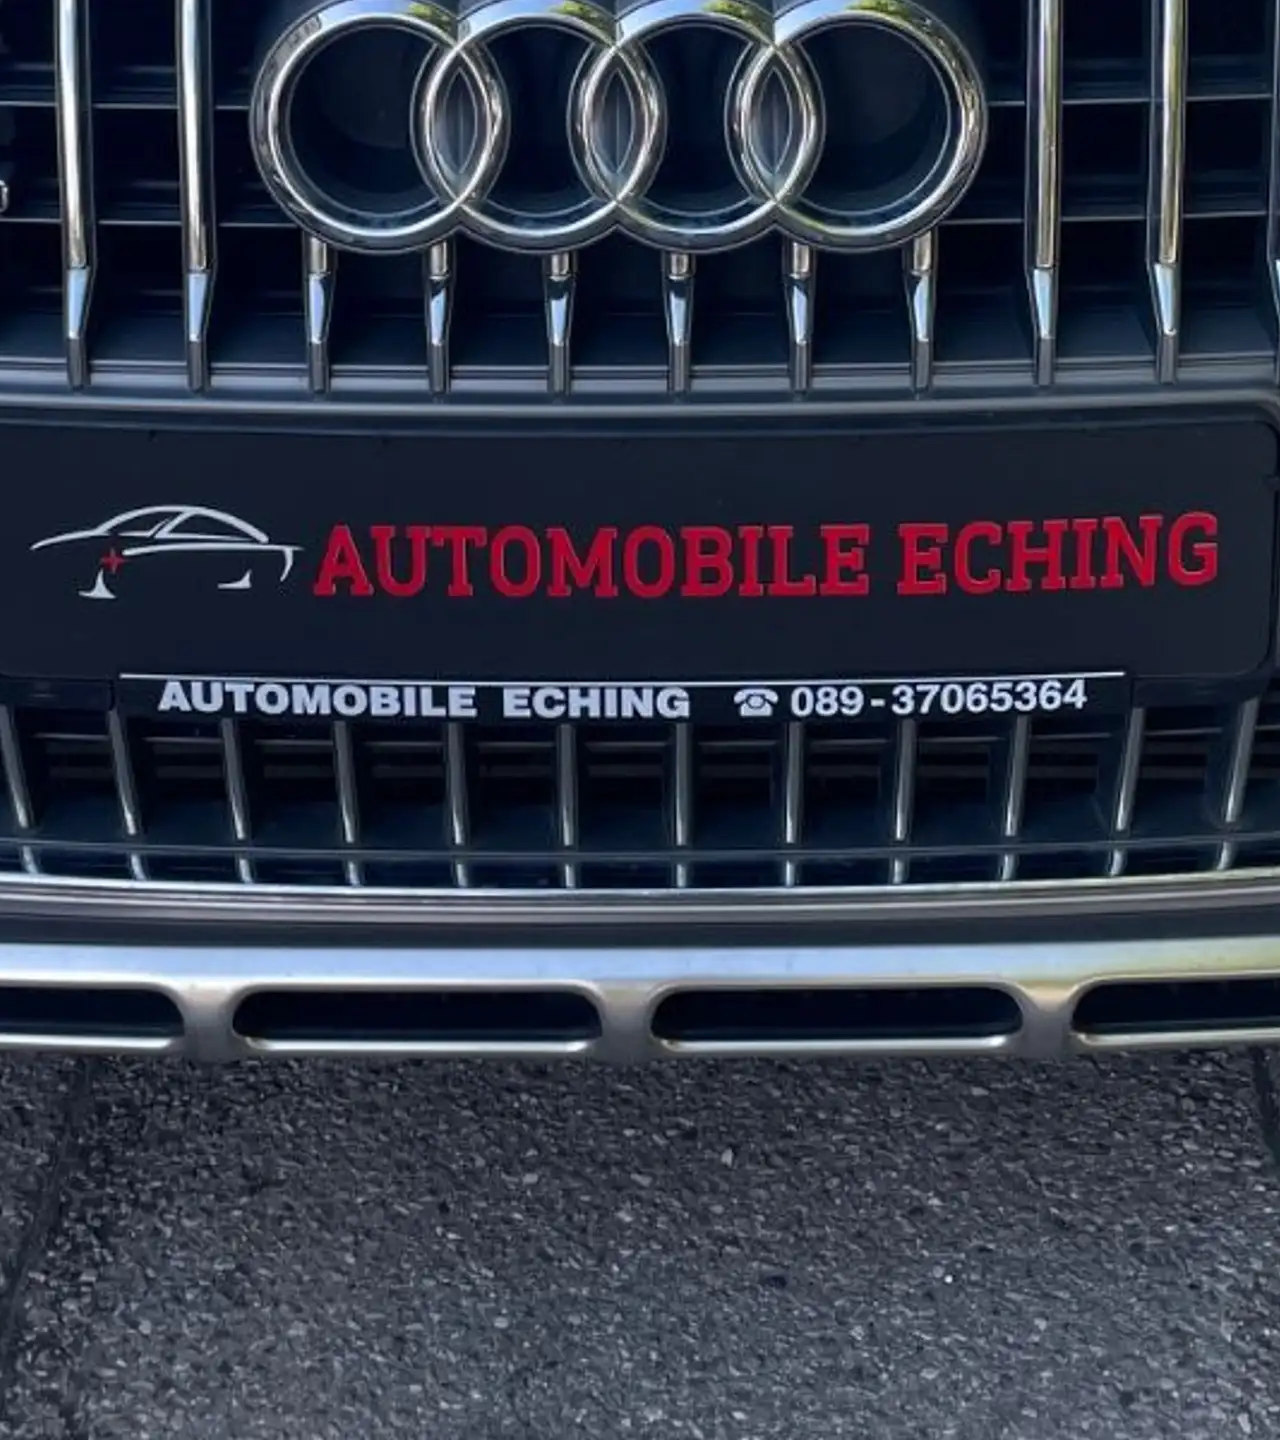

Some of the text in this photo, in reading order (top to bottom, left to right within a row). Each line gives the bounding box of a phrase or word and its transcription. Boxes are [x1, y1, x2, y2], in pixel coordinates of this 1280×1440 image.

[313, 510, 1219, 598] AUTOMOBILE ECHING
[157, 680, 478, 718] AUTOMOBILE
[502, 684, 691, 719] ECHING
